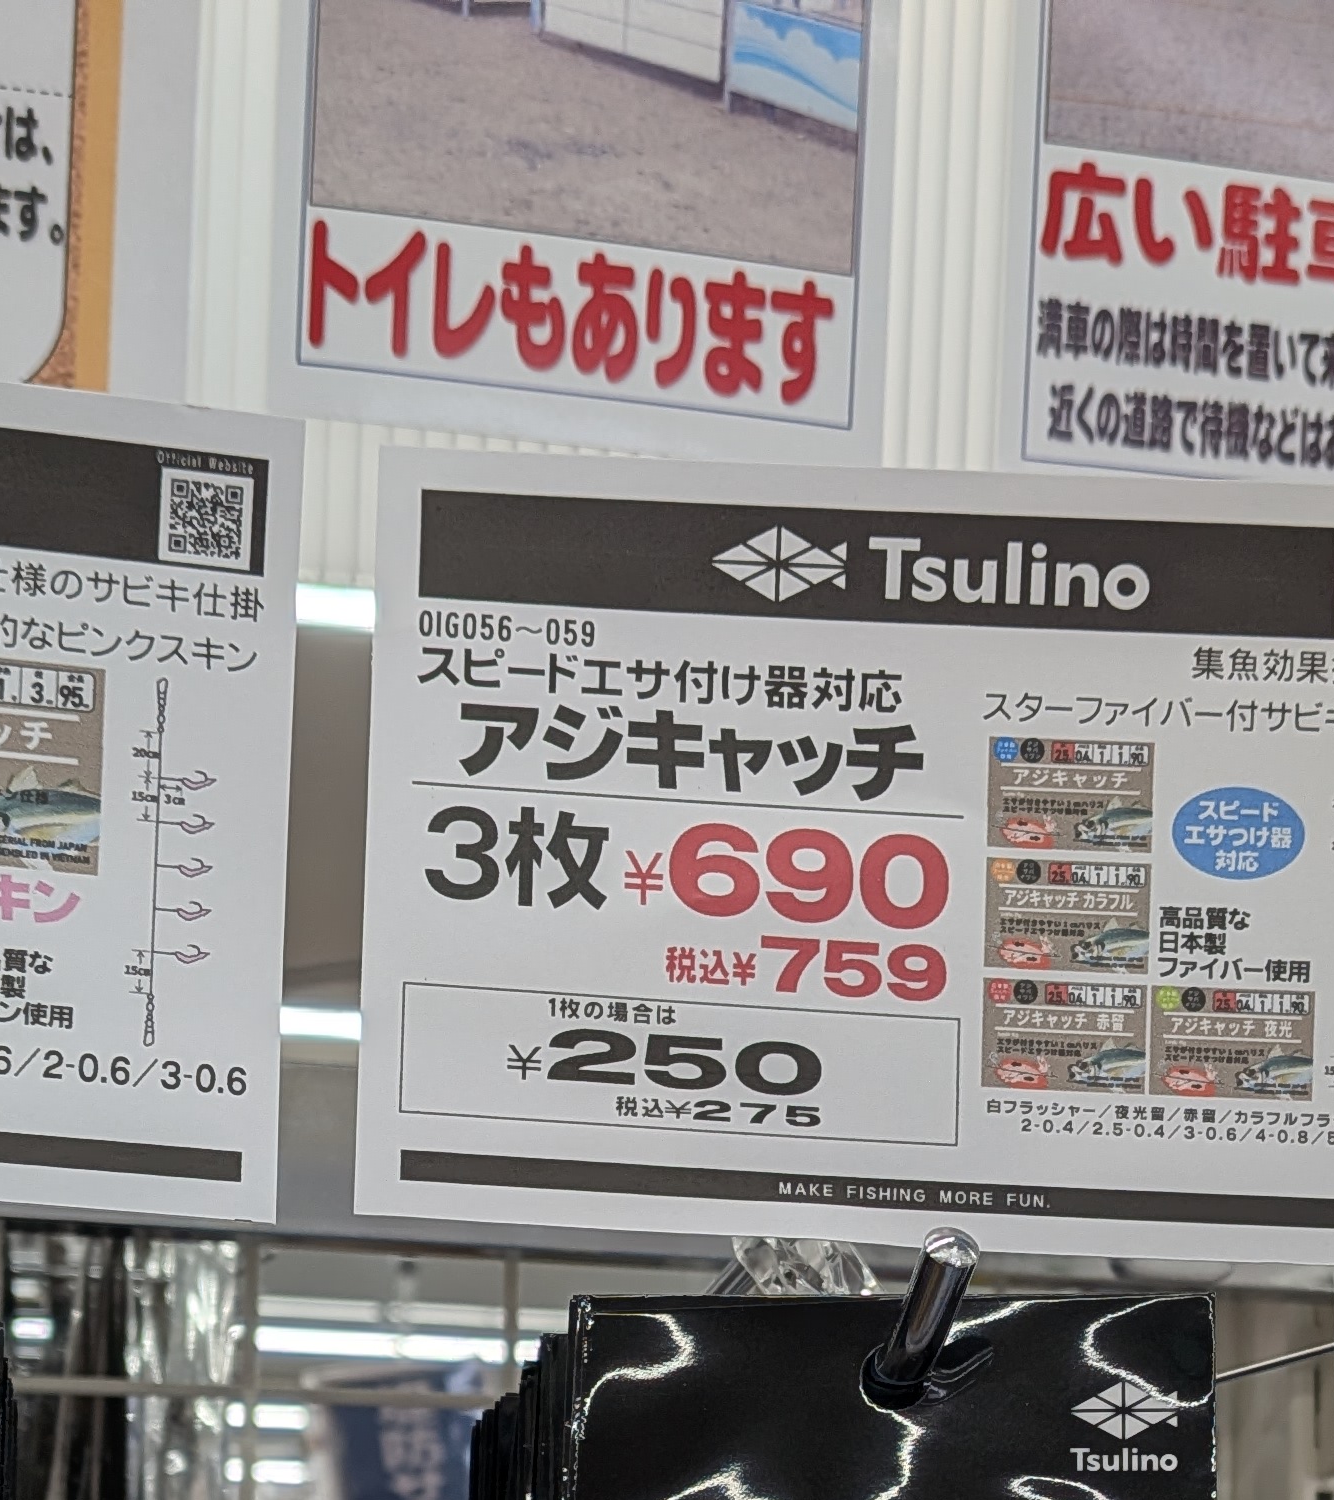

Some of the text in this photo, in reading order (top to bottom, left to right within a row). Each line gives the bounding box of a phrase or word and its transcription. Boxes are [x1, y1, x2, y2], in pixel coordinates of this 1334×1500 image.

[308, 219, 836, 406] トイレもあります
[869, 535, 1151, 611] Tsulino
[417, 646, 904, 714] スピードエサ付け器対応
[459, 702, 924, 802] アジキャッチ
[1013, 768, 1128, 788] アジキャッチ
[1198, 801, 1279, 822] スピード
[1183, 824, 1293, 849] エサつけ器
[425, 806, 950, 930] 3枚 ¥690
[1215, 850, 1260, 874] 対応
[1004, 889, 1134, 910] アジキャッチ カラフル
[1158, 904, 1251, 931] 高品質な
[1158, 930, 1227, 956] 日本製
[665, 936, 947, 1002] 税込¥759
[1157, 956, 1312, 985] ファイバー使用
[548, 997, 677, 1027] 1枚の場合は
[1003, 1009, 1125, 1031] アジキャッチ 赤留
[1170, 1017, 1293, 1038] アジキャッチ 夜光
[506, 1028, 822, 1097] ¥250
[615, 1096, 822, 1128] 税込¥275
[778, 1181, 1052, 1210] MAKE FISHING MORE FUN.
[1070, 1447, 1179, 1473] Tsulino
